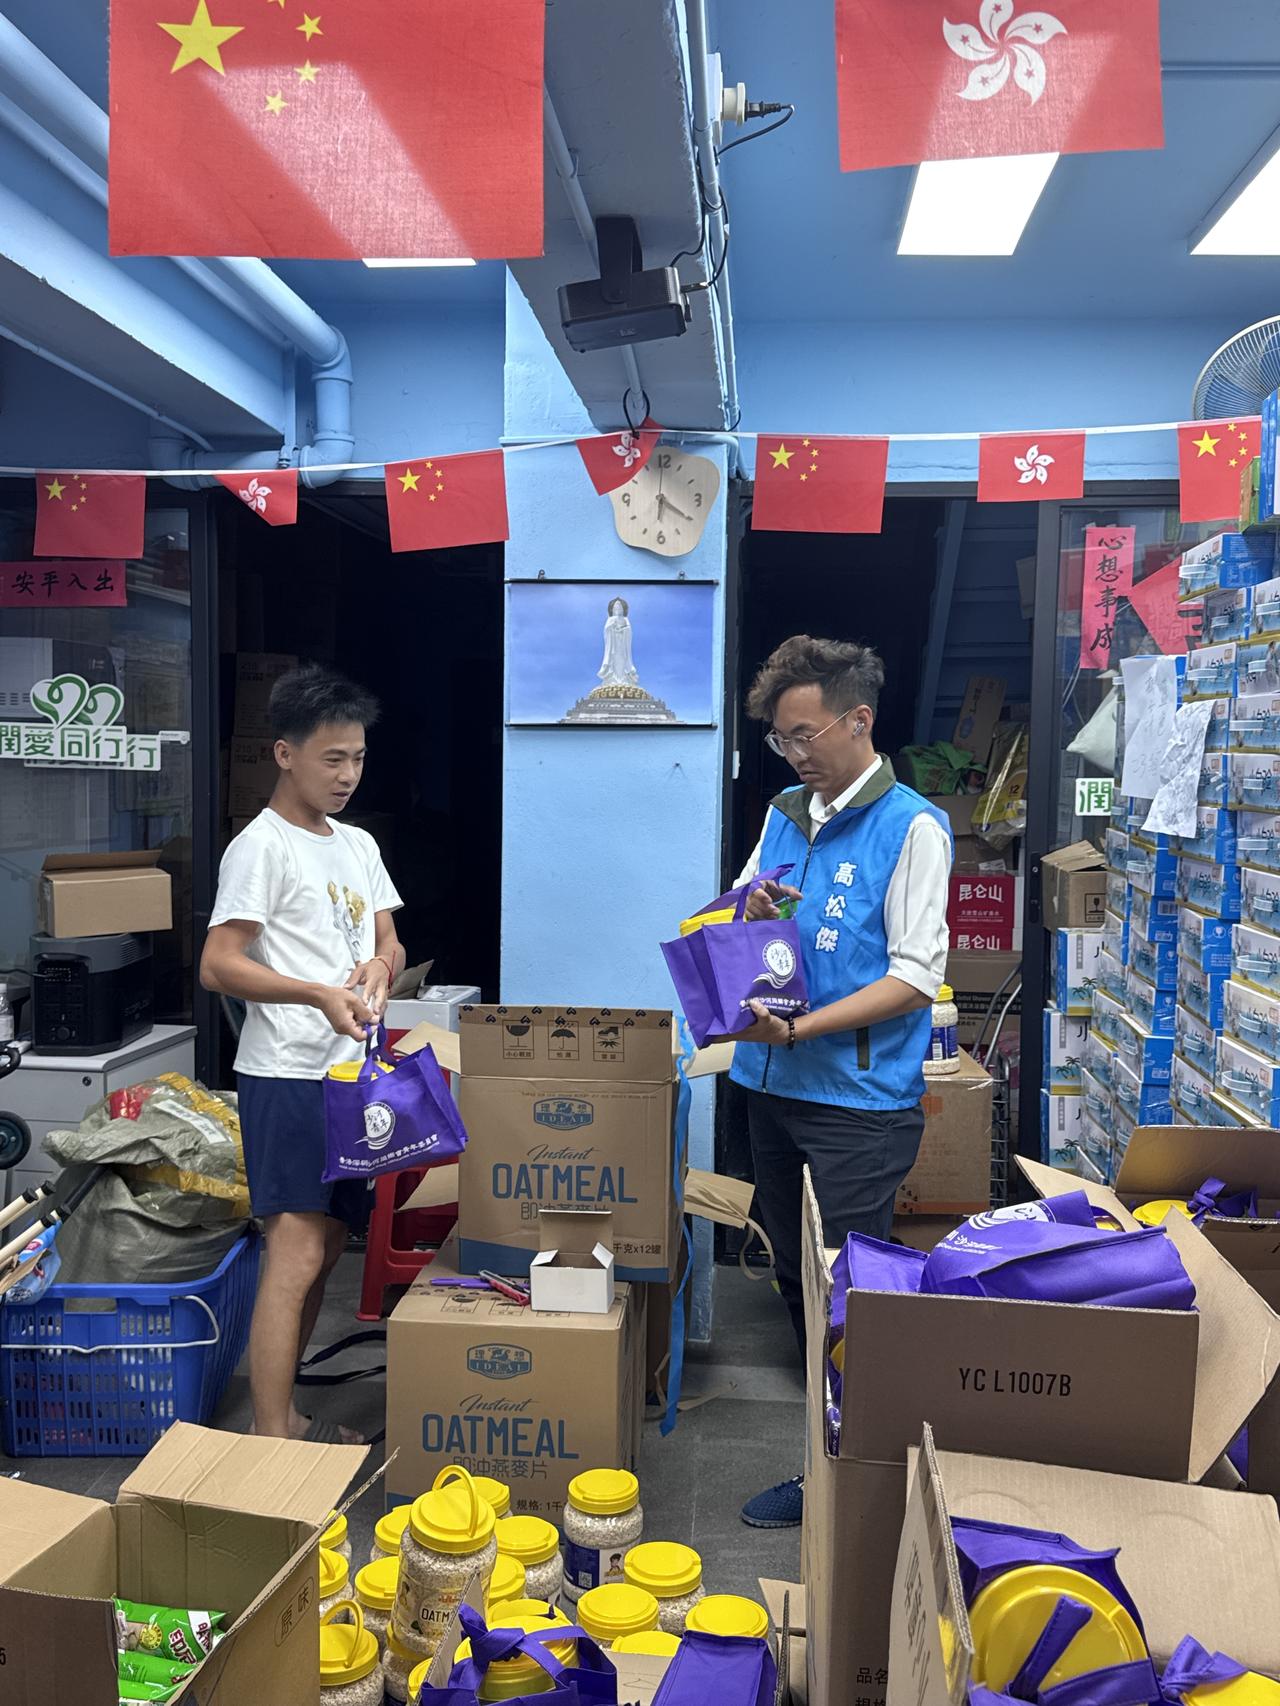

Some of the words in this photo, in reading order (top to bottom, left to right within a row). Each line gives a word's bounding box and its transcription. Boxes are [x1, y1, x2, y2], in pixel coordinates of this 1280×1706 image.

[658, 454, 672, 469] 12
[622, 493, 631, 507] 9
[694, 492, 703, 507] 3
[657, 530, 666, 545] 6
[959, 884, 1004, 903] 昆仑山
[957, 934, 1001, 951] 昆仑山
[541, 1115, 586, 1123] IDEAL
[526, 1143, 600, 1162] Instant
[491, 1162, 639, 1204] OATMEAL
[475, 1361, 522, 1373] IDEAL
[459, 1393, 539, 1414] Instant
[422, 1413, 580, 1460] OATMEAL
